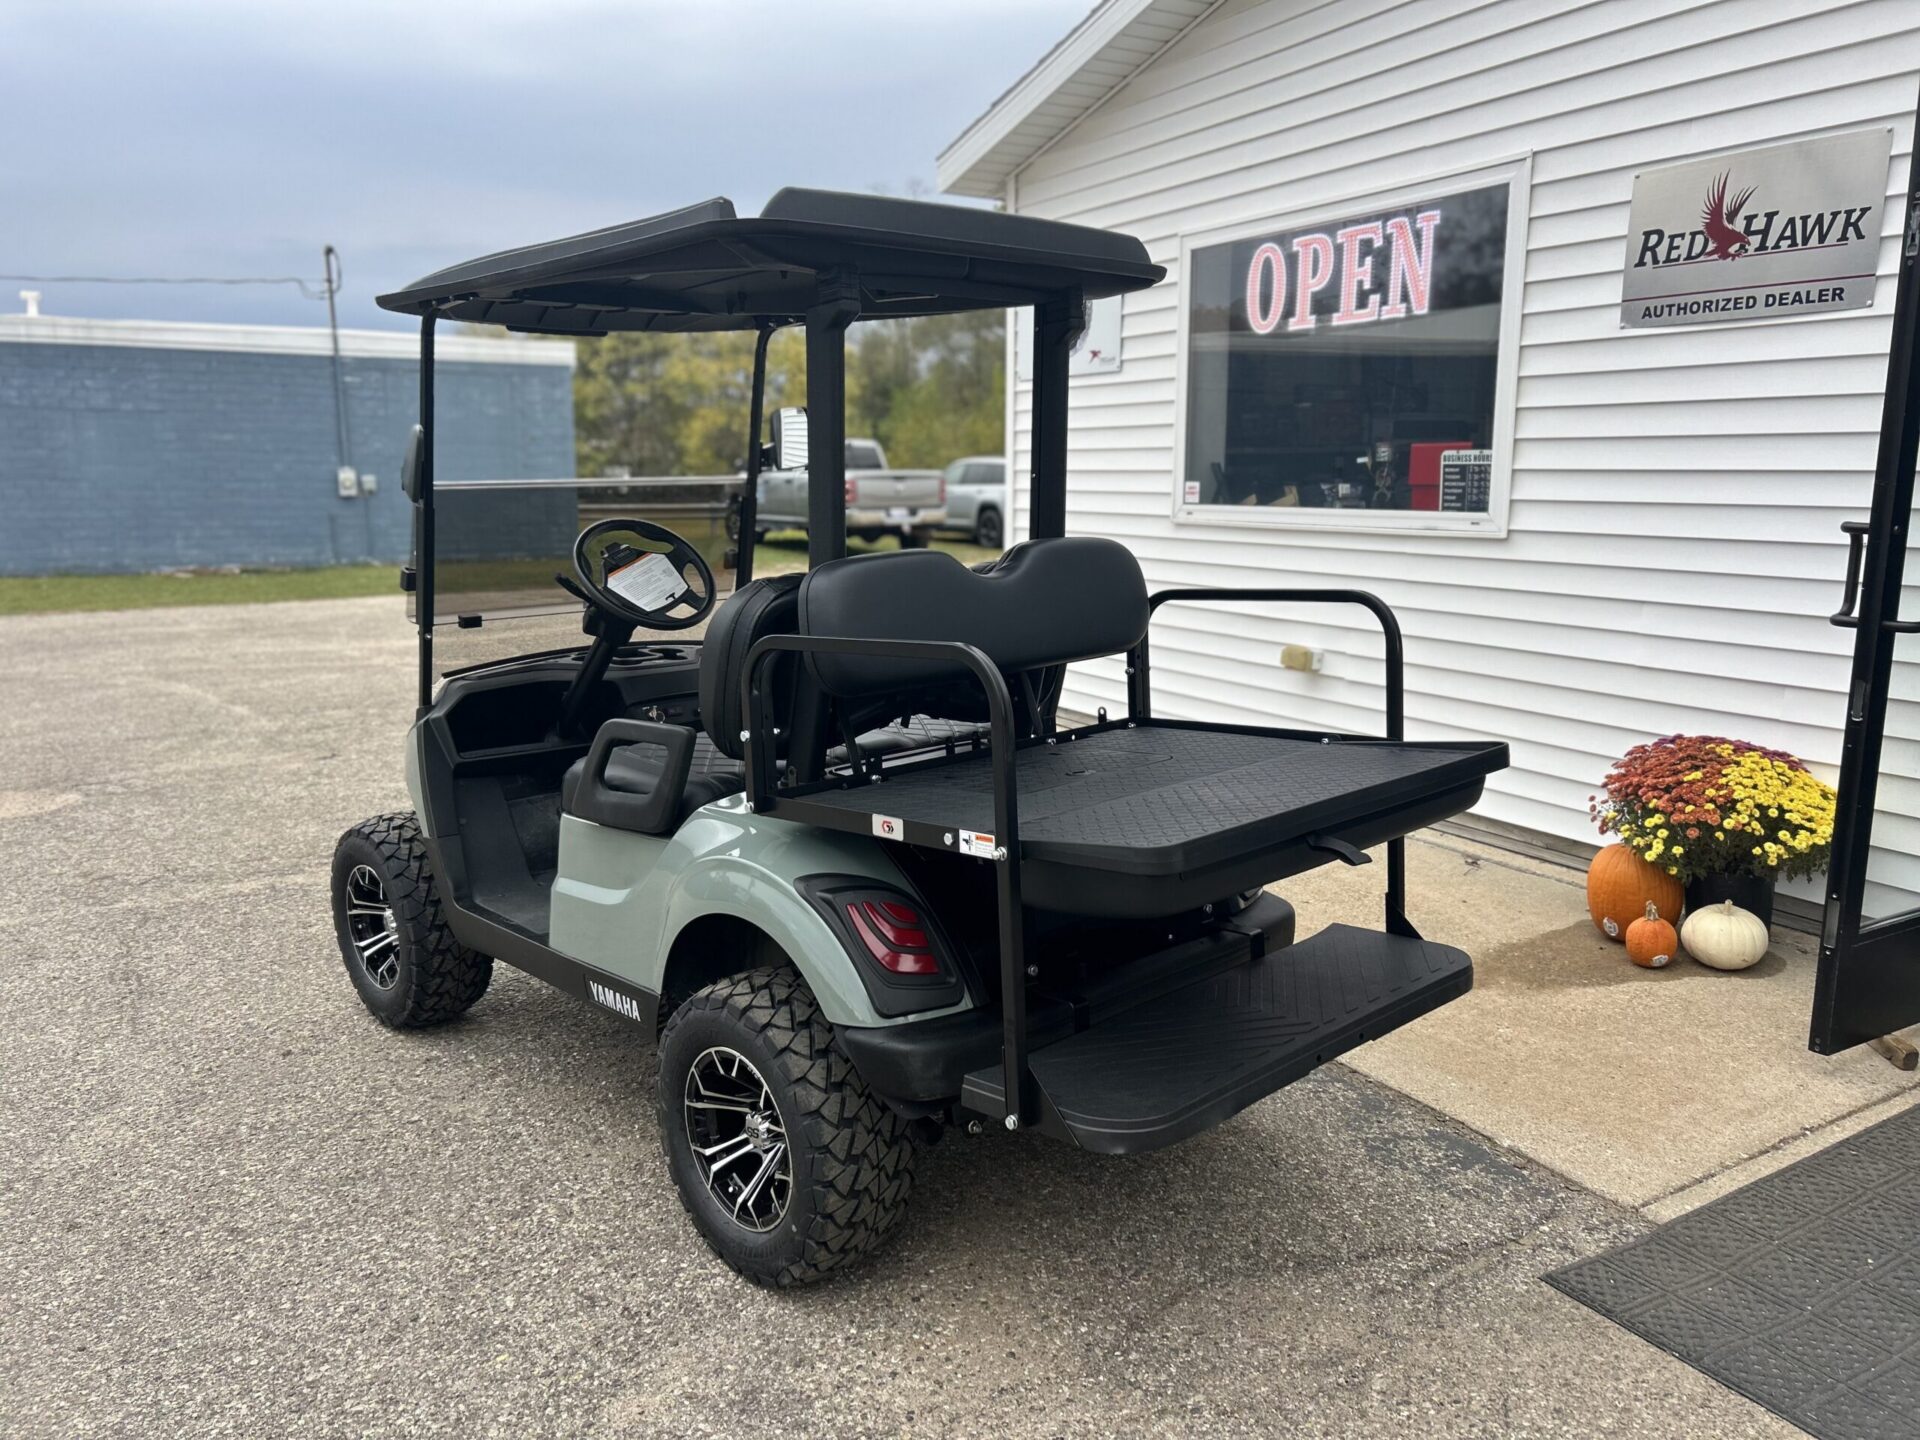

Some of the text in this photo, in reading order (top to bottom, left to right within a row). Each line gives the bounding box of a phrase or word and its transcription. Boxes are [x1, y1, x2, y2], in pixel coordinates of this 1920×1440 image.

[1633, 206, 1872, 268] RED HAWK
[1246, 209, 1441, 335] OPEN
[1641, 287, 1845, 319] AUTHORIZED DEALER
[1443, 454, 1472, 463] BUSINESS
[589, 980, 641, 1022] YAMAHA
